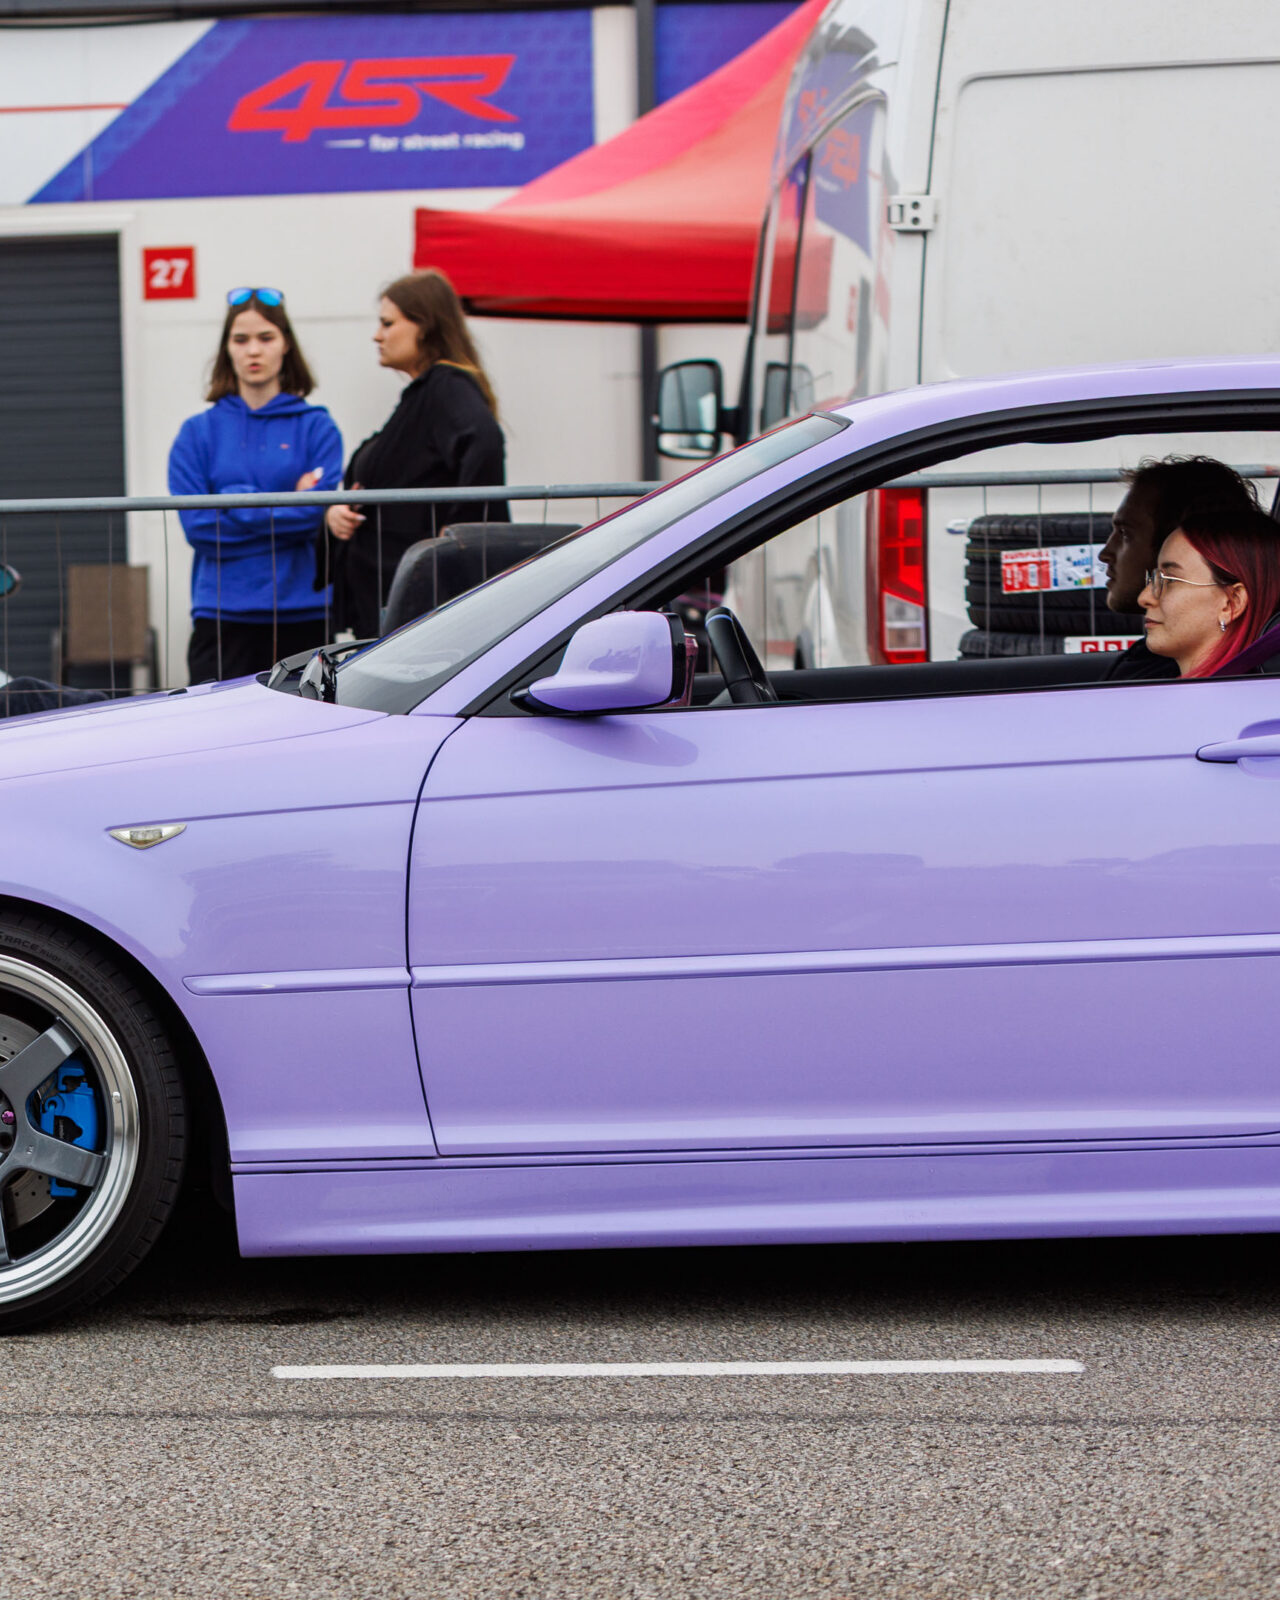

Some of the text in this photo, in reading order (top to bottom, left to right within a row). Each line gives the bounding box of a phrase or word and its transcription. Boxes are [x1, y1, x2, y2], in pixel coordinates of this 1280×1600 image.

[369, 131, 525, 152] for street racing
[149, 259, 188, 288] 27
